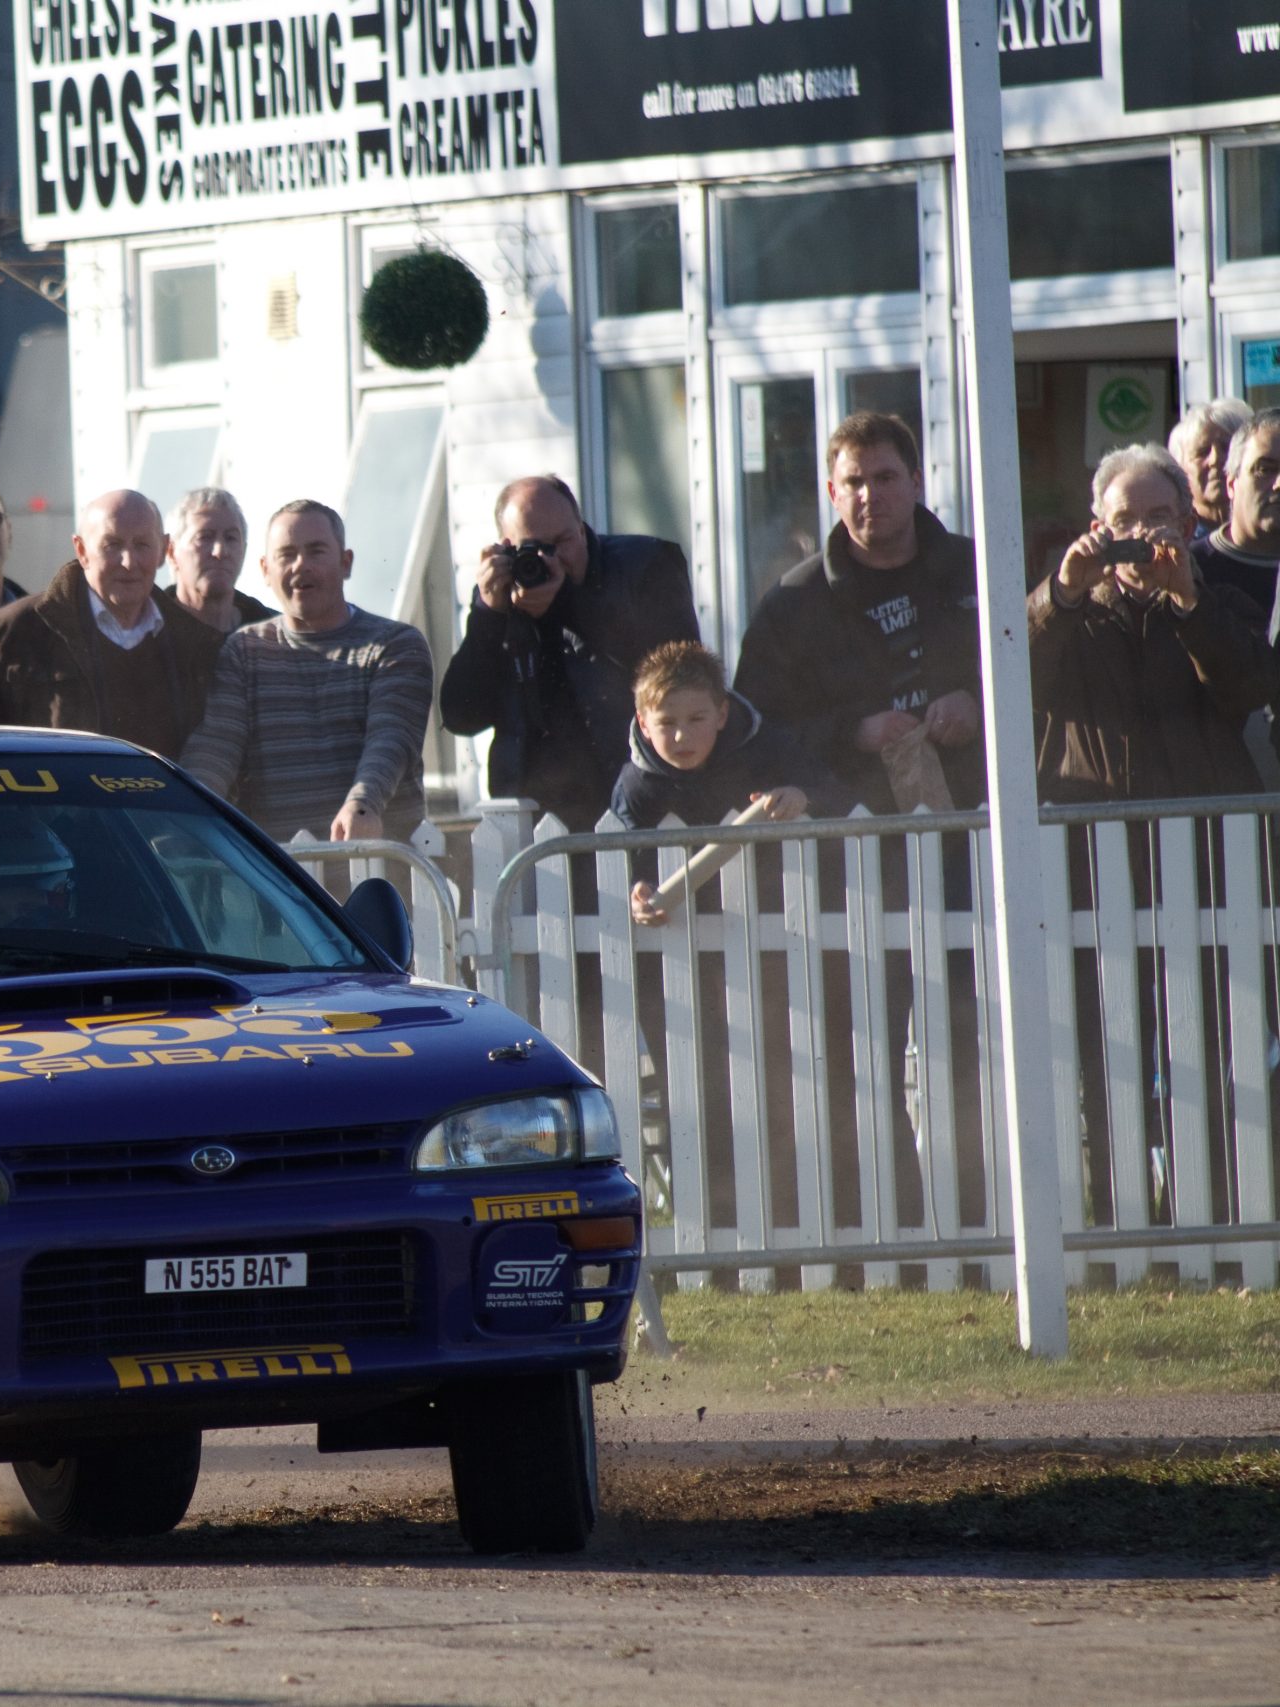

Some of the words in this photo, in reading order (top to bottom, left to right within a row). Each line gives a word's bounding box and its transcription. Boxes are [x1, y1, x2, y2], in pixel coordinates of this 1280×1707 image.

[29, 0, 141, 65] CHEESE
[397, 0, 538, 78] PICKLES
[998, 0, 1093, 51] AYRE
[186, 13, 346, 127] CATERING
[351, 0, 392, 180] TTE
[150, 0, 185, 202] AKES
[673, 79, 696, 115] for
[697, 84, 736, 113] more
[33, 70, 148, 216] EGGS
[399, 92, 490, 178] CREAM
[494, 87, 547, 170] TEA
[21, 1041, 415, 1075] SUBARU
[472, 1191, 579, 1221] PIRELLI
[190, 1258, 235, 1289] 555
[243, 1256, 288, 1287] BAT
[486, 1292, 525, 1300] SUBARU
[526, 1291, 564, 1299] TECNICA
[485, 1299, 564, 1308] INTERNATIONAL
[108, 1343, 353, 1389] PIRELLI
